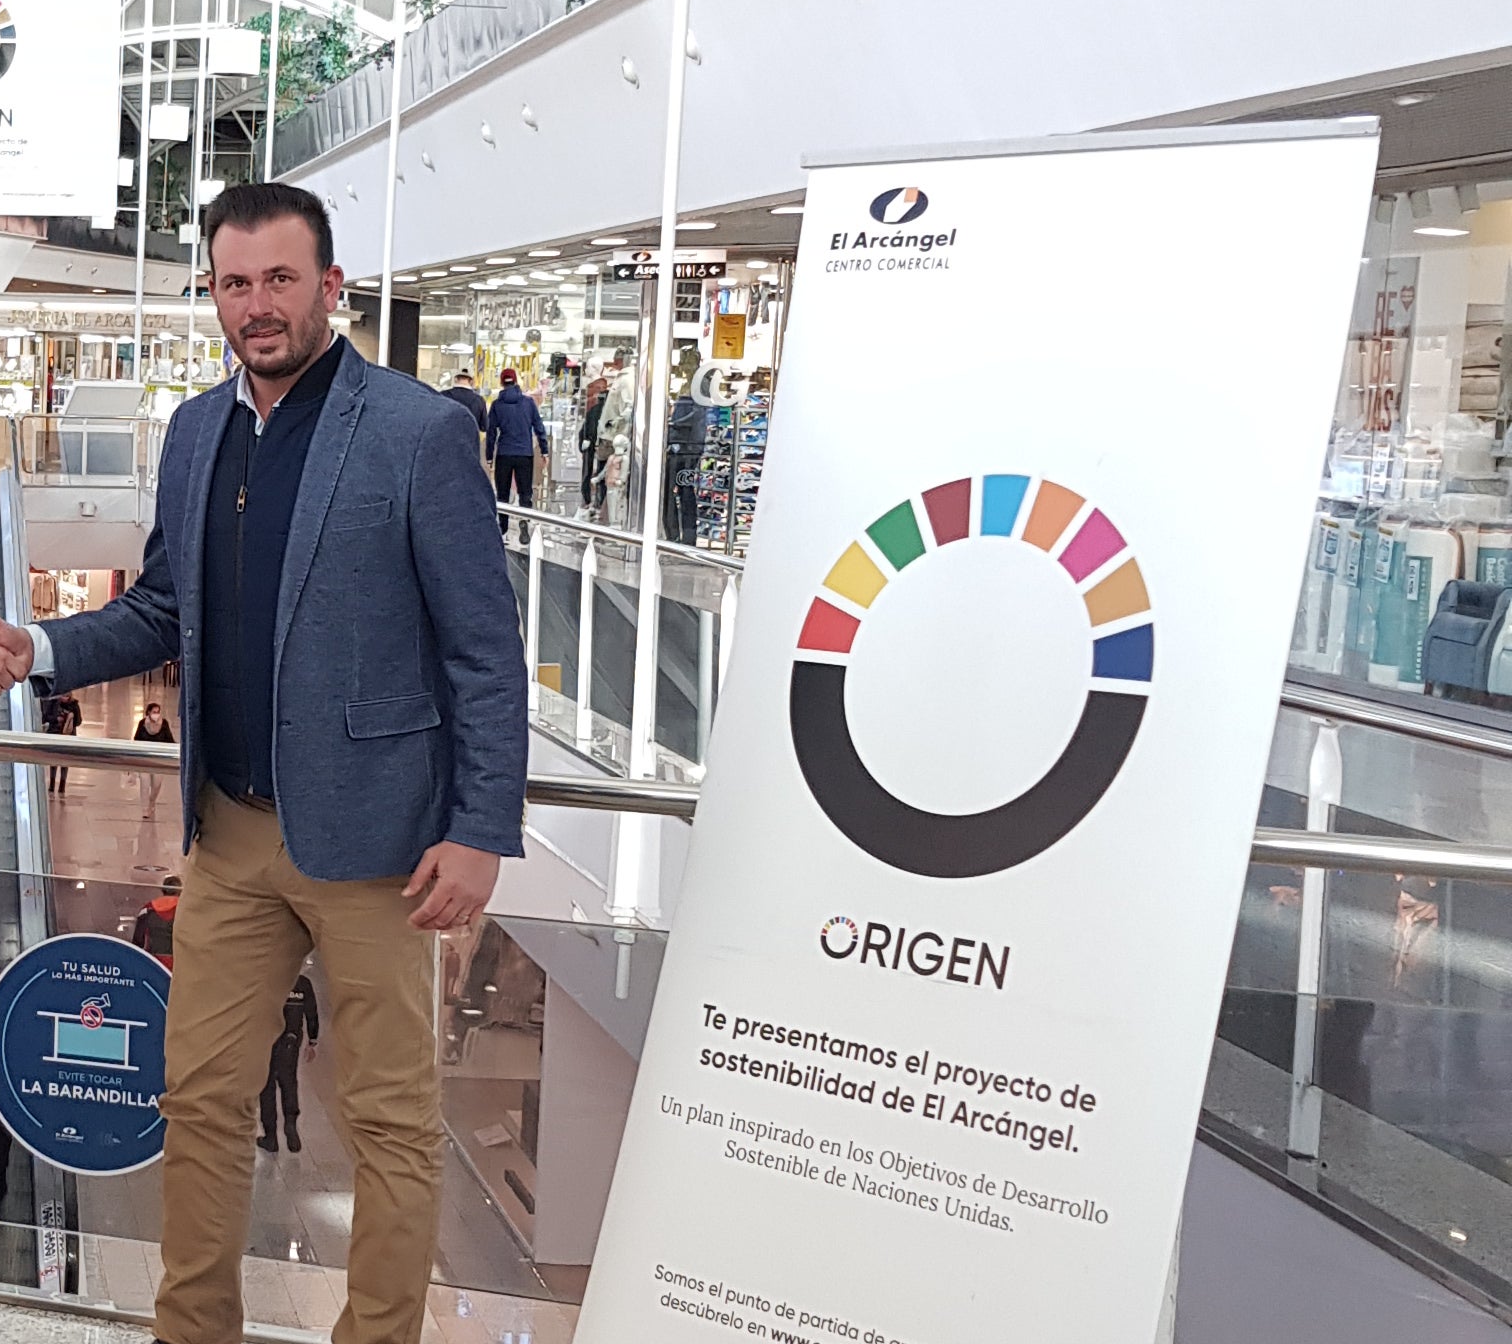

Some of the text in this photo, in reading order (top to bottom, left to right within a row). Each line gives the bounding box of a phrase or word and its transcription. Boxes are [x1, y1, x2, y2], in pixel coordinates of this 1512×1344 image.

[830, 228, 957, 252] El Arcángel
[825, 257, 950, 273] CENTRO COMERCIAL
[95, 312, 172, 329] ARCAGEL
[62, 961, 120, 976] TU SALUD
[820, 916, 1010, 990] ORIGEN
[51, 971, 135, 987] LO MÁS IMPORTANTE
[703, 1004, 1097, 1112] Te presentamos el proyecto de
[21, 1079, 159, 1109] LA BARANDILLA
[58, 1070, 123, 1086] EVITE TOCAR
[699, 1047, 1079, 1153] sostenibilidad de El Arcángel.
[660, 1094, 1109, 1224] Un plan inspirado en los Objetivos de Desarrollo
[724, 1139, 1015, 1233] Sostenible de Naciones Unidas.
[654, 1264, 705, 1293] Somos
[708, 1282, 723, 1298] el
[724, 1288, 771, 1313] punto
[774, 1302, 795, 1320] de
[798, 1311, 859, 1341] partida
[660, 1292, 744, 1330] descúbrelo
[747, 1321, 767, 1337] en
